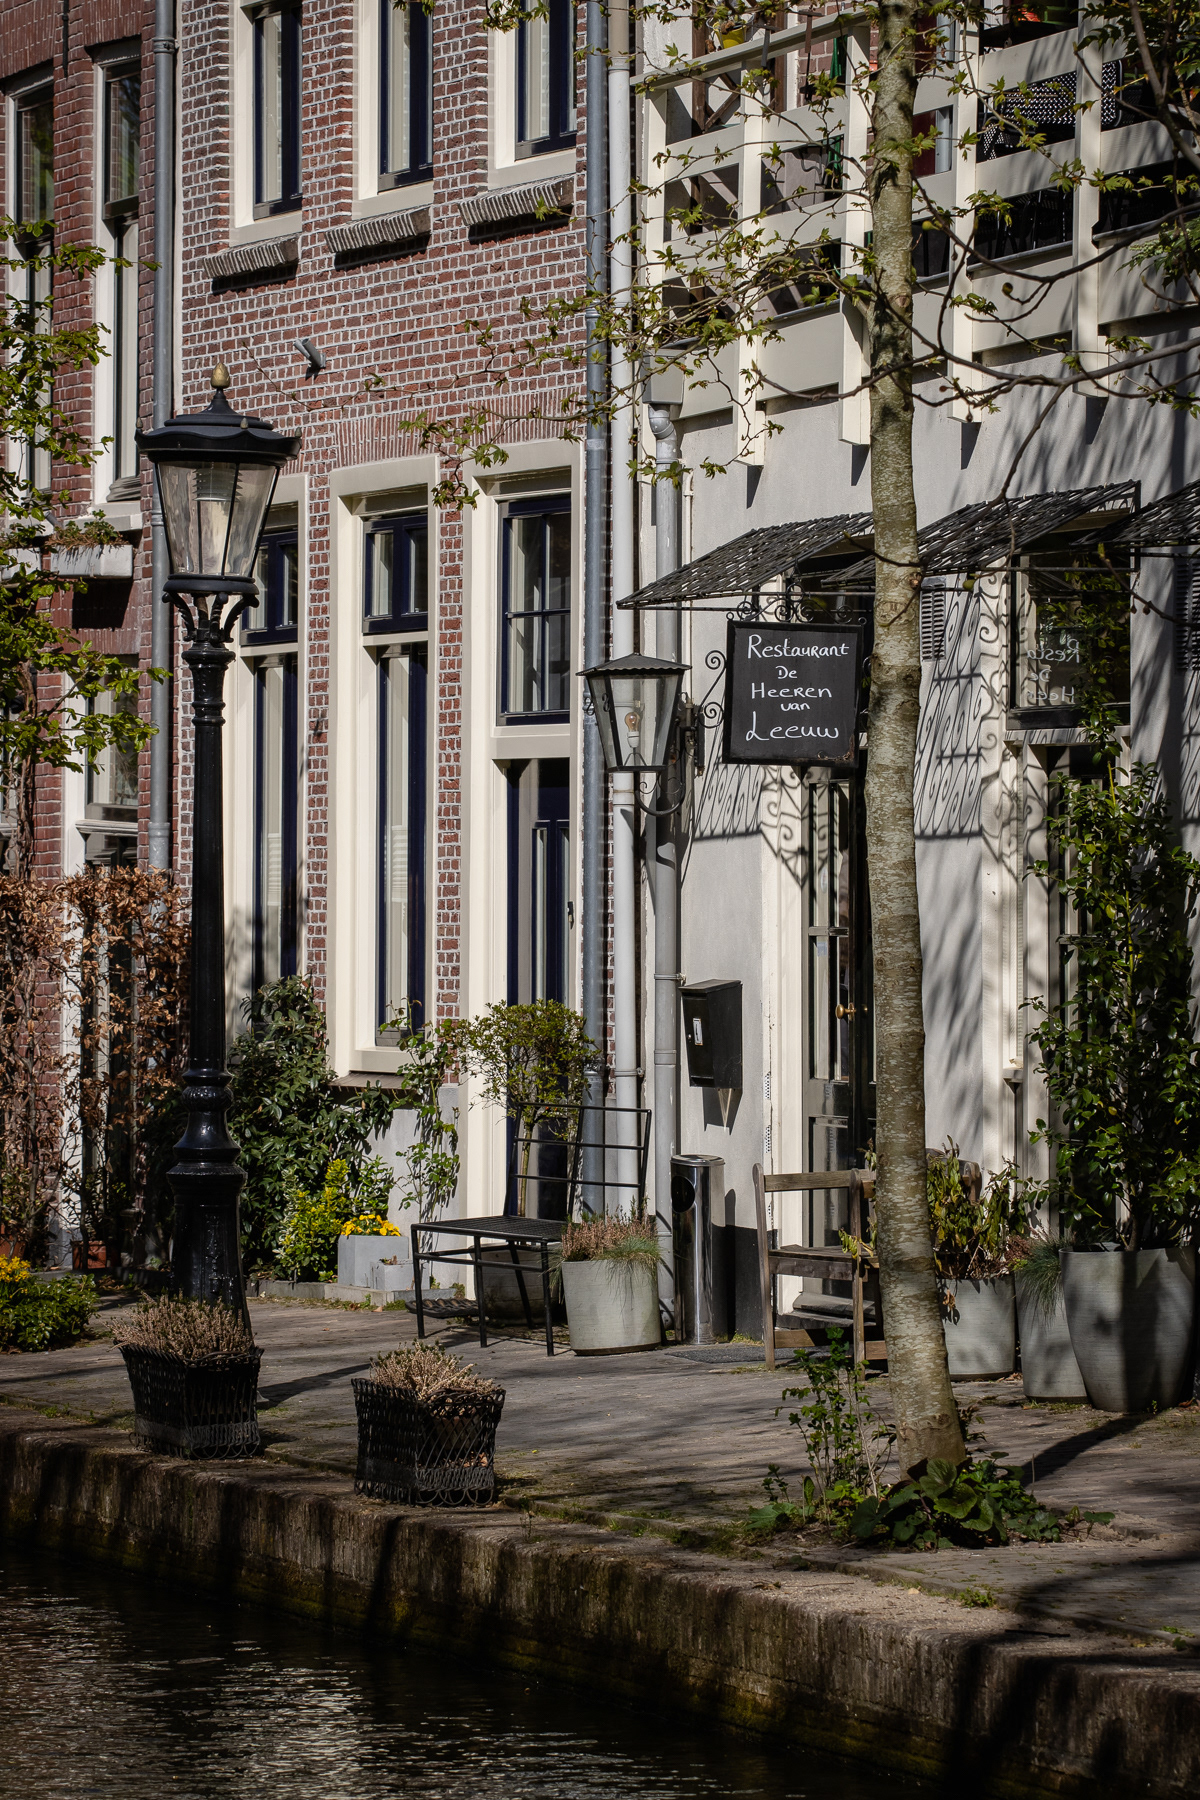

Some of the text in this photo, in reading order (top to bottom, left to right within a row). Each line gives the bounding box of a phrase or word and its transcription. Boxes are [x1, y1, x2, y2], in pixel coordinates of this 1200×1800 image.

[747, 634, 850, 659] Restaurant
[775, 665, 798, 680] De
[780, 702, 811, 712] van
[745, 711, 839, 742] Leeuw
